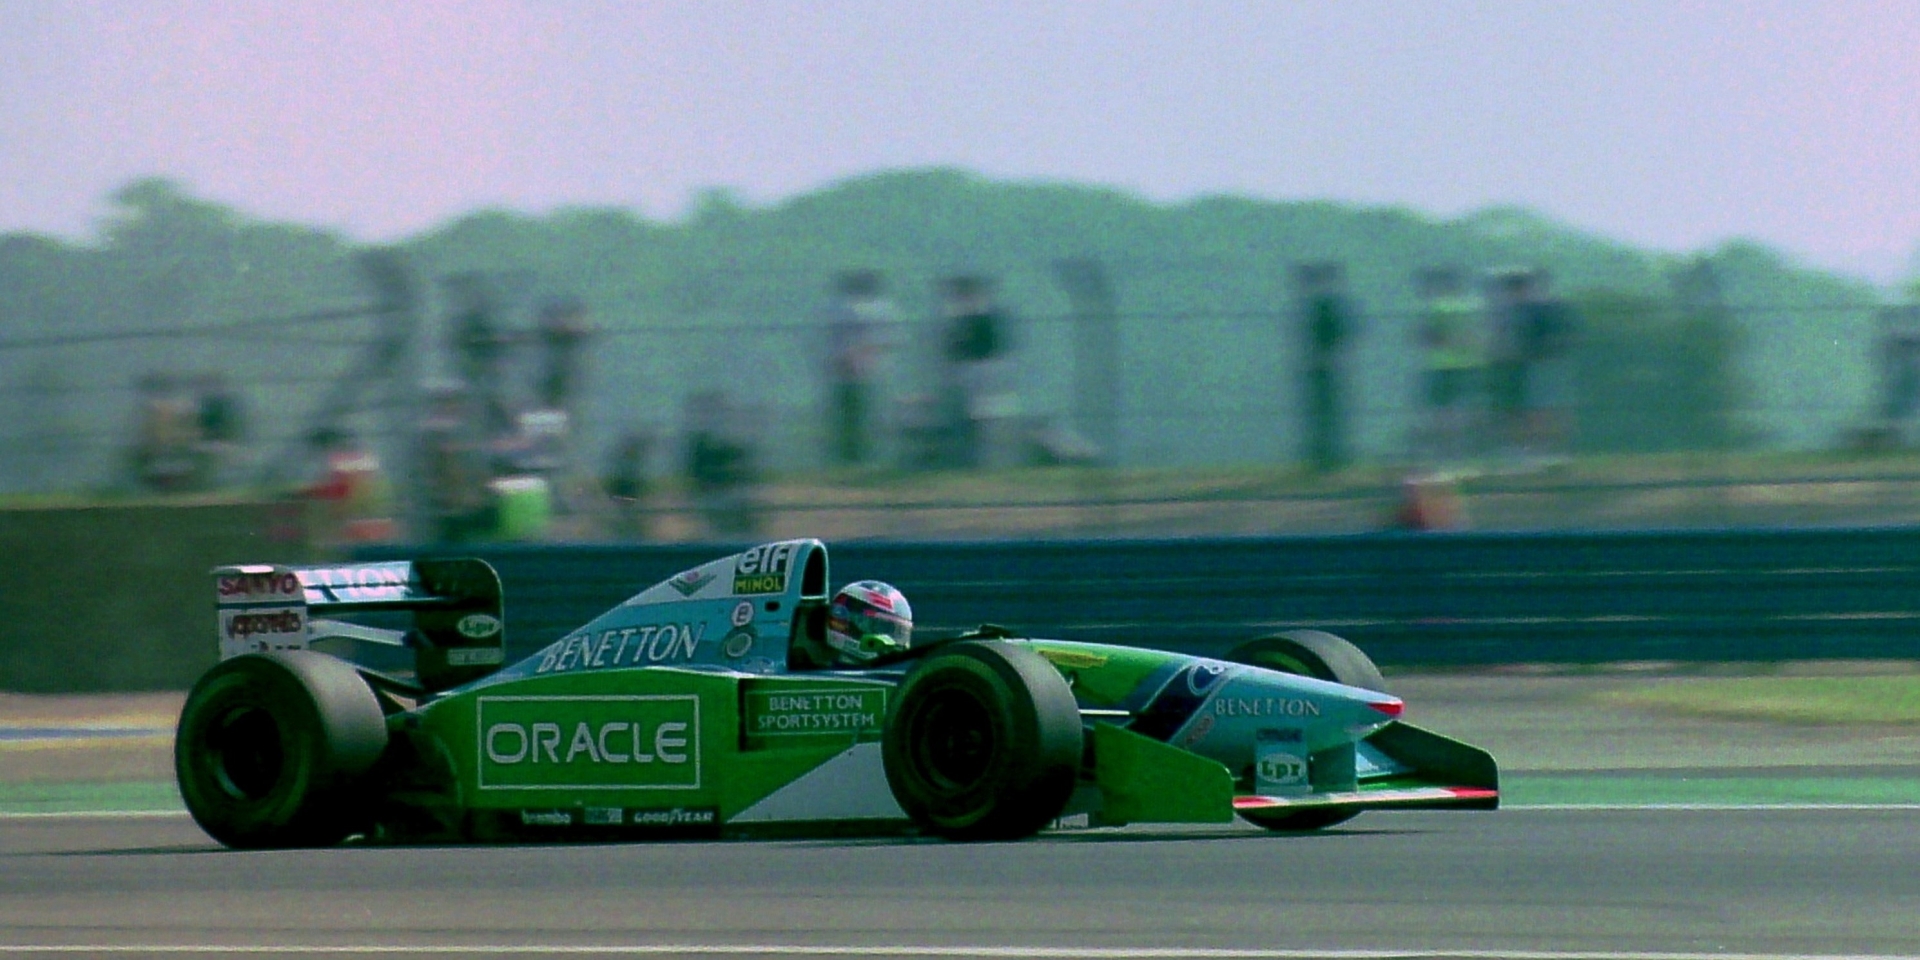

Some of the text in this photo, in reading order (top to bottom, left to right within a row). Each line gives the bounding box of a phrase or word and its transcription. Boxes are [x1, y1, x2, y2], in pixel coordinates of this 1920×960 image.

[739, 544, 789, 574] elf
[736, 577, 782, 591] MINOL
[536, 623, 706, 673] BENETTON
[769, 695, 863, 711] BENETTON
[1215, 698, 1320, 716] BENETTON
[758, 713, 875, 729] SPORTSYSTEM
[487, 722, 687, 763] ORACLE
